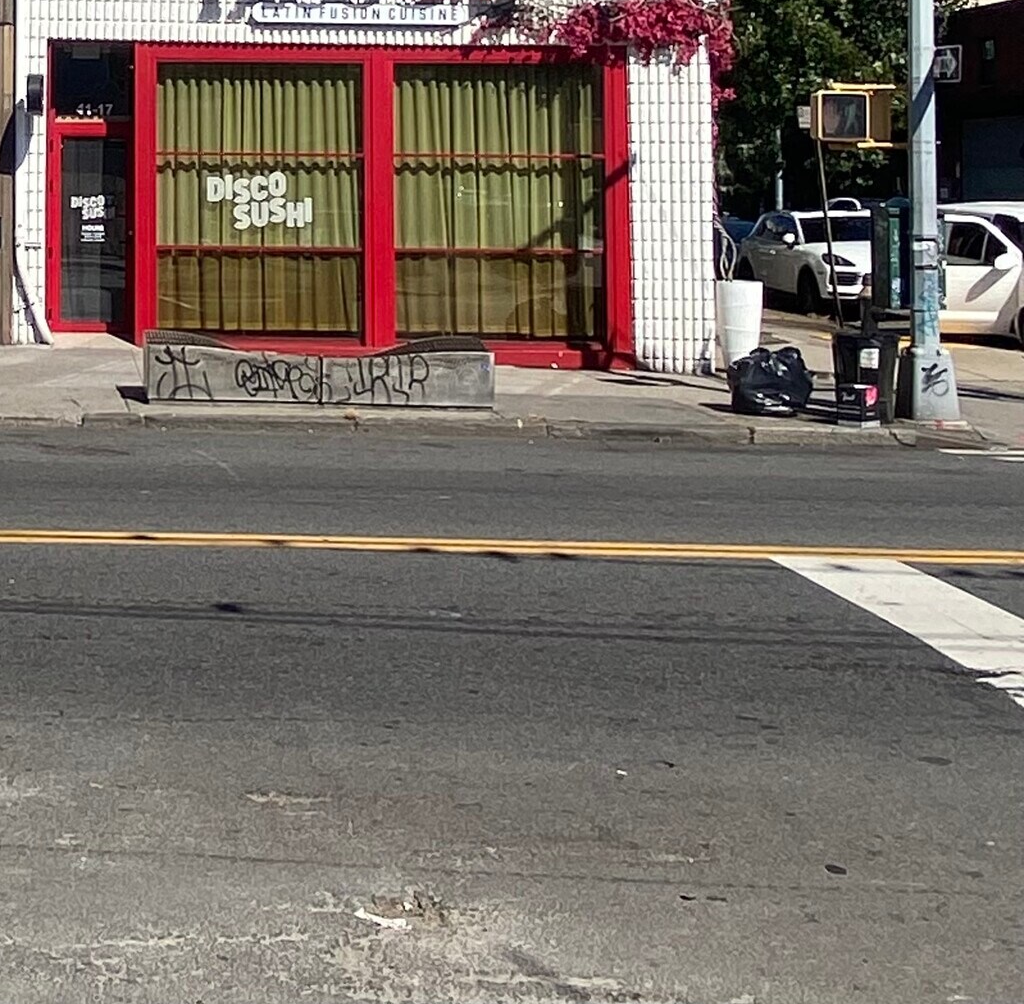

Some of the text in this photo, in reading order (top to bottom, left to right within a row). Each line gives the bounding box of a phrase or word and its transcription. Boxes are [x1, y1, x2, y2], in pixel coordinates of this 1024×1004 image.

[261, 5, 458, 21] LATIN FUSION CUISINE
[207, 172, 287, 204] DISCO
[70, 195, 105, 208] DISCO
[233, 197, 313, 230] SUSHI
